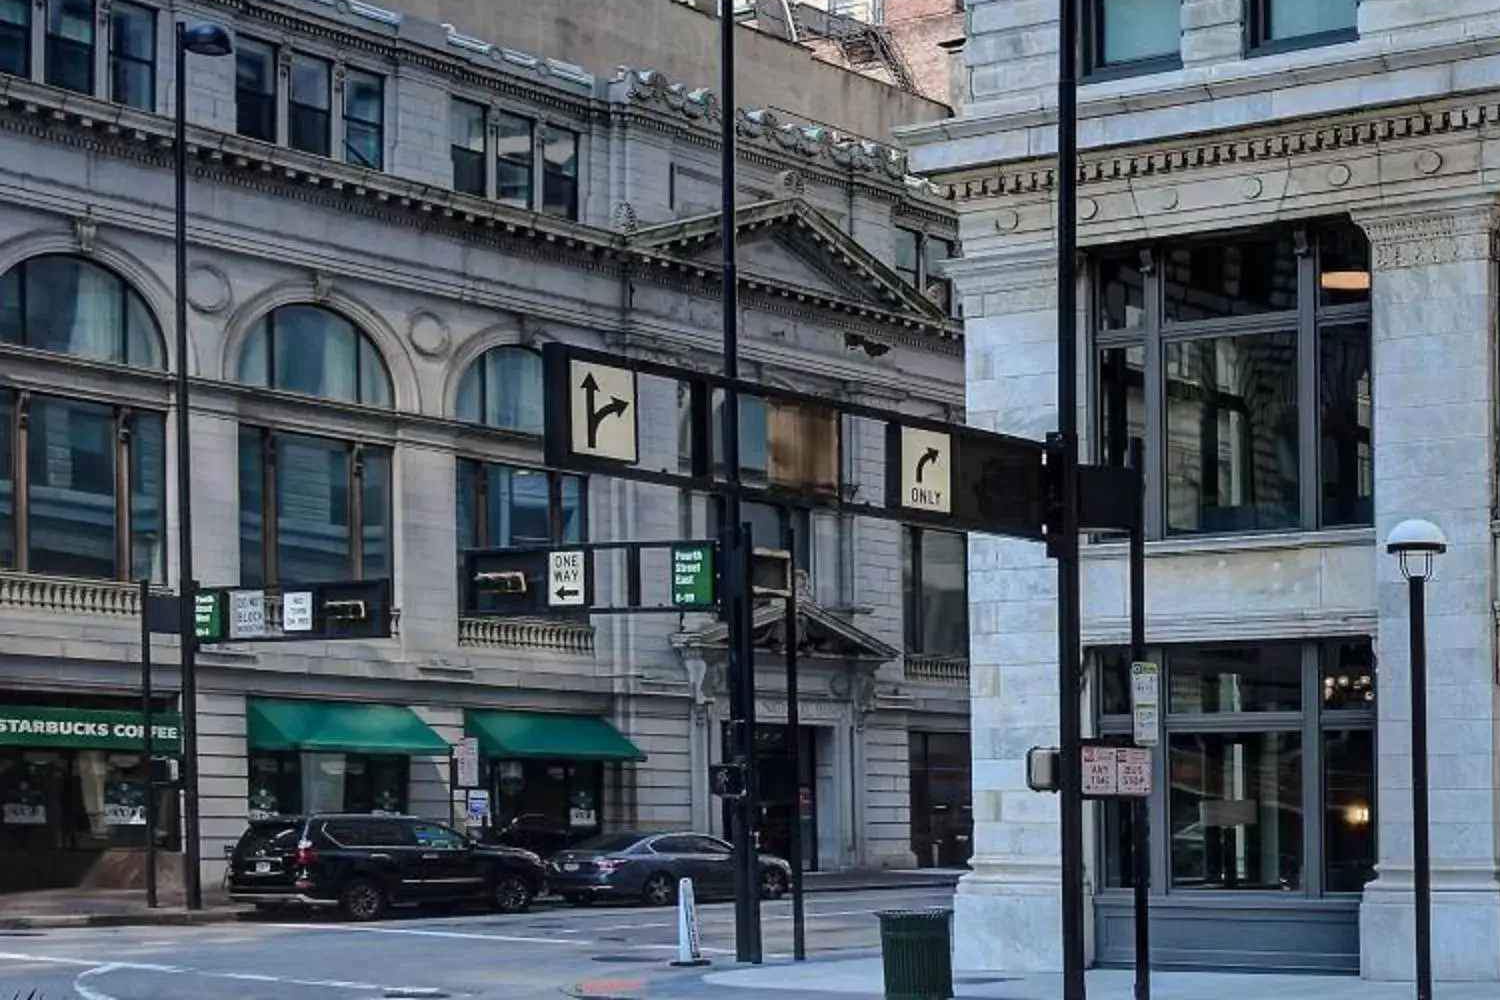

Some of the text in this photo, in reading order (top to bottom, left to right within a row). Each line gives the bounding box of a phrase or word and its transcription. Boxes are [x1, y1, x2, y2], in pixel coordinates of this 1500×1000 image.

[911, 487, 942, 505] ONLY
[675, 549, 703, 561] Fourth
[555, 555, 578, 569] ONE
[675, 563, 701, 573] Street
[554, 570, 579, 583] WAY
[0, 719, 109, 737] STARBUCKS
